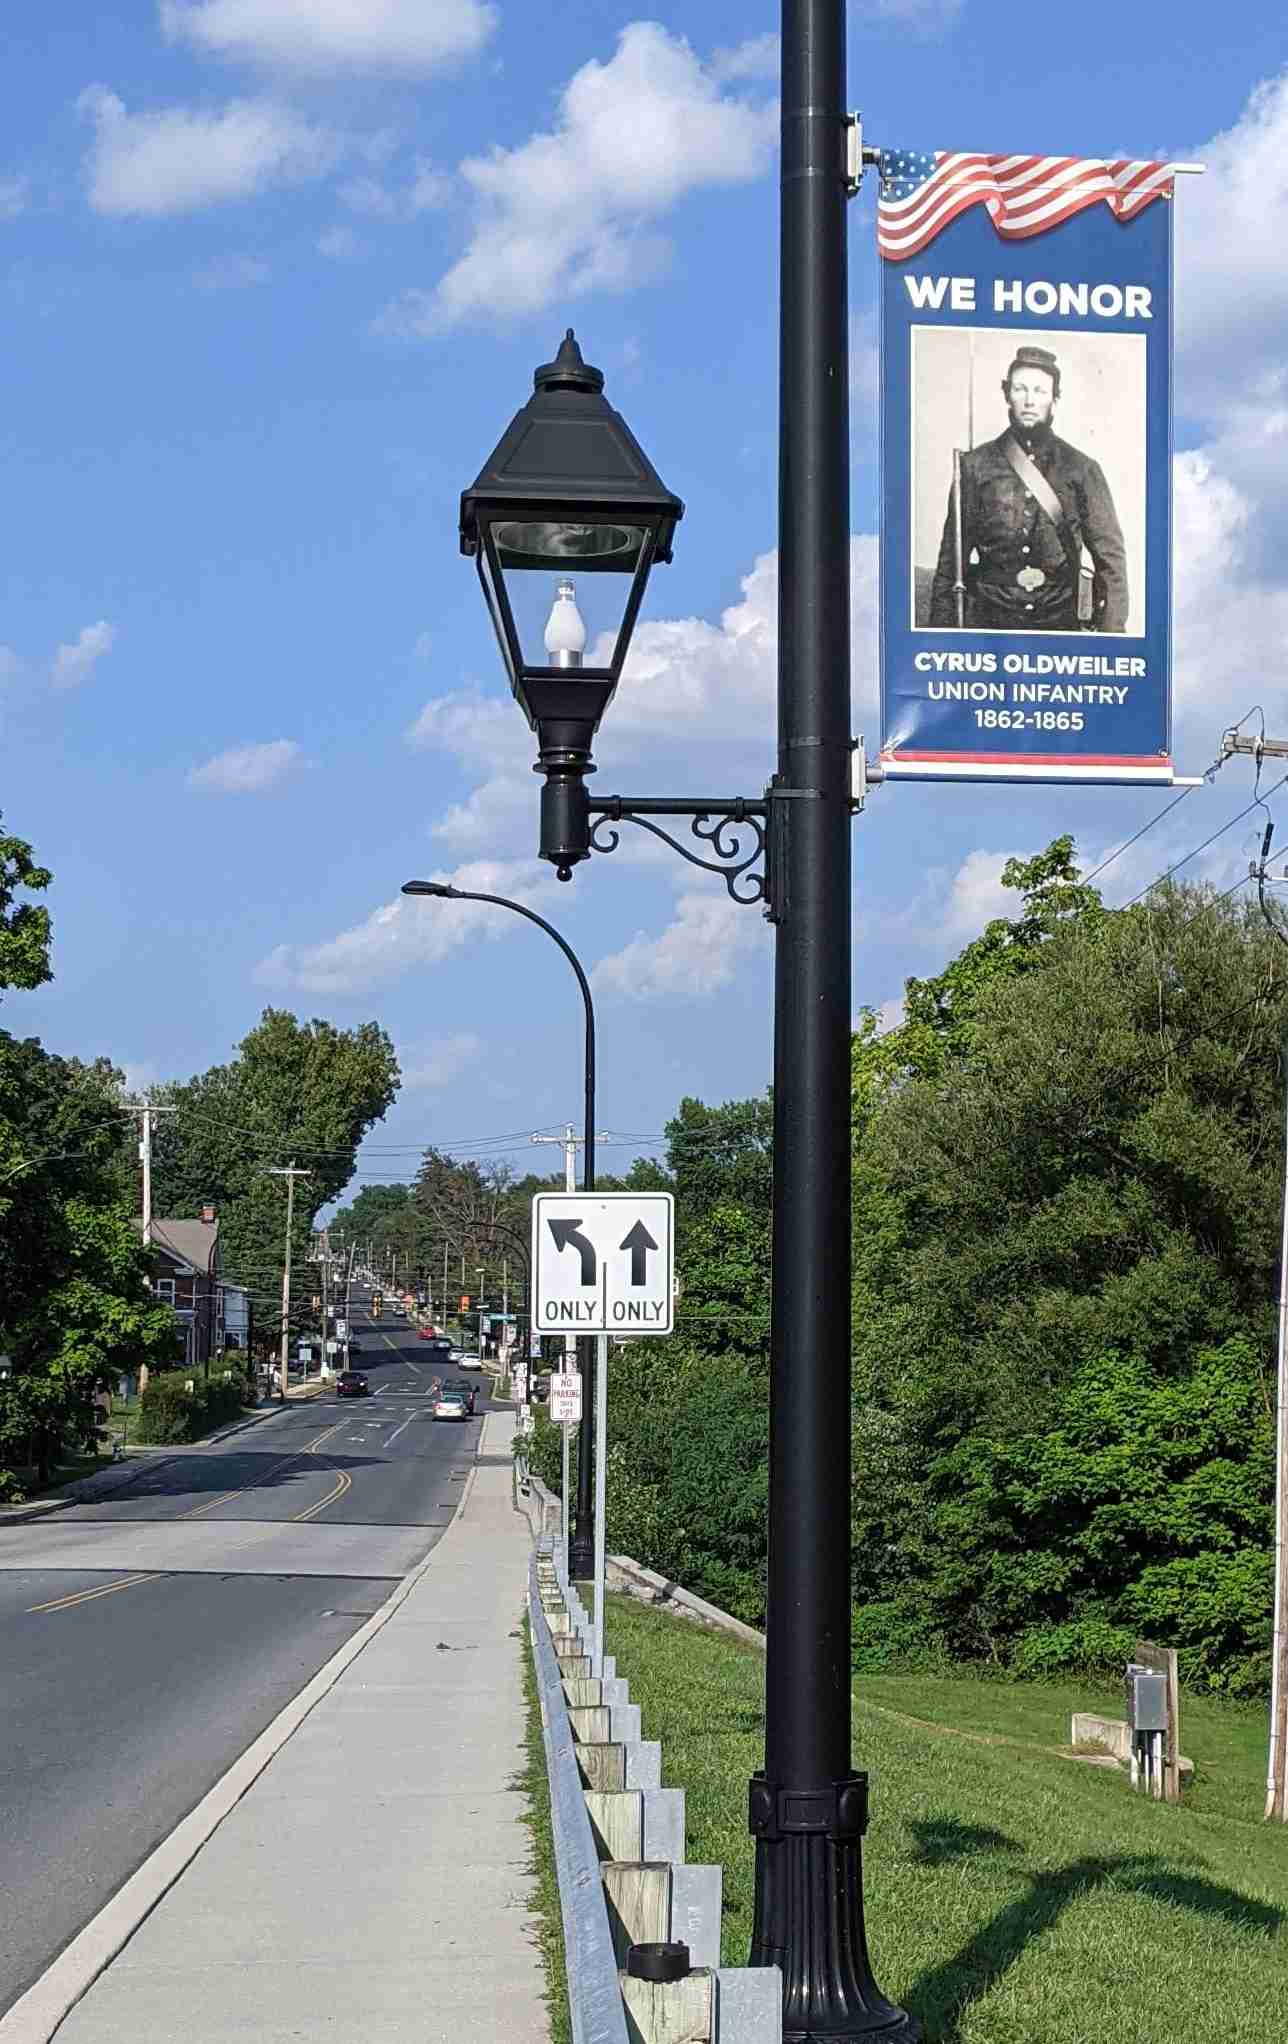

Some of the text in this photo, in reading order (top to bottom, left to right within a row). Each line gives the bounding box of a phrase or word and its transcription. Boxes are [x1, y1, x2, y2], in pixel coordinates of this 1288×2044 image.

[904, 275, 1153, 318] WE HONOR
[914, 652, 1147, 677] CYRUS OLDWEILER
[928, 681, 1129, 705] UNION INFANTRY
[974, 709, 1085, 731] 1862-1865
[545, 1300, 597, 1321] ONLY
[613, 1300, 665, 1321] ONLY
